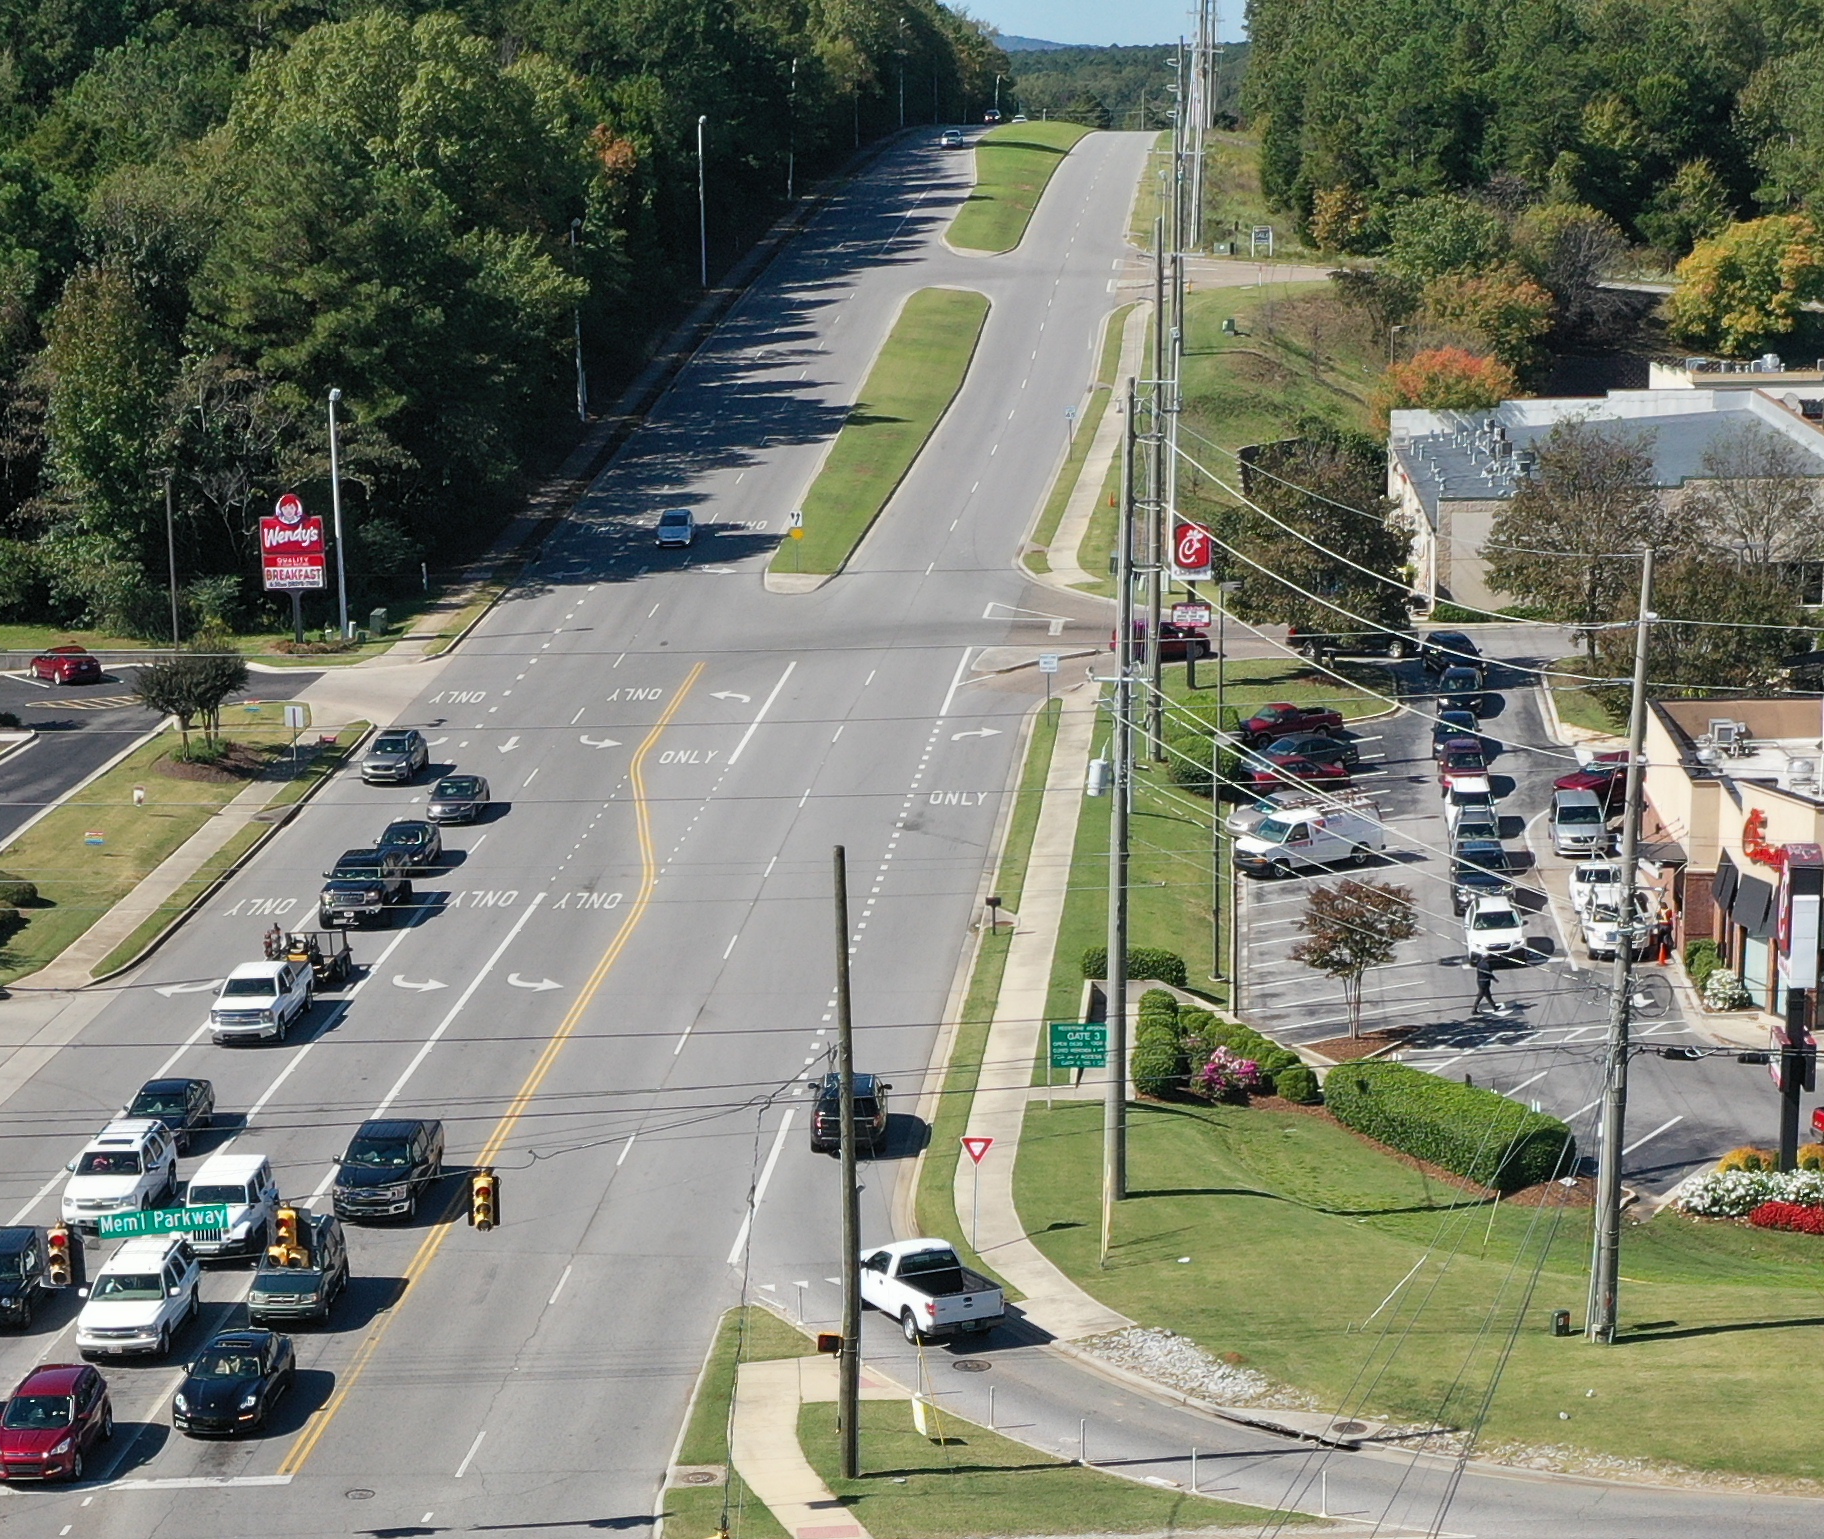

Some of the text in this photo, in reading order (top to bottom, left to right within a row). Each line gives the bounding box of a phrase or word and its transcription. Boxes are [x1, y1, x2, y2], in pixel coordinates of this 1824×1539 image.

[264, 524, 318, 548] Wendy's
[266, 569, 322, 581] BREAKFAST
[428, 691, 486, 704] ONLY
[607, 688, 662, 702] ONLY
[659, 750, 719, 764] ONLY
[929, 790, 988, 806] ONLY
[223, 898, 297, 916] ONLY
[448, 890, 519, 908] ONLY
[552, 893, 623, 910] ONLY
[1067, 1032, 1100, 1040] GATE 3
[100, 1208, 225, 1234] Mem'l Parkway
